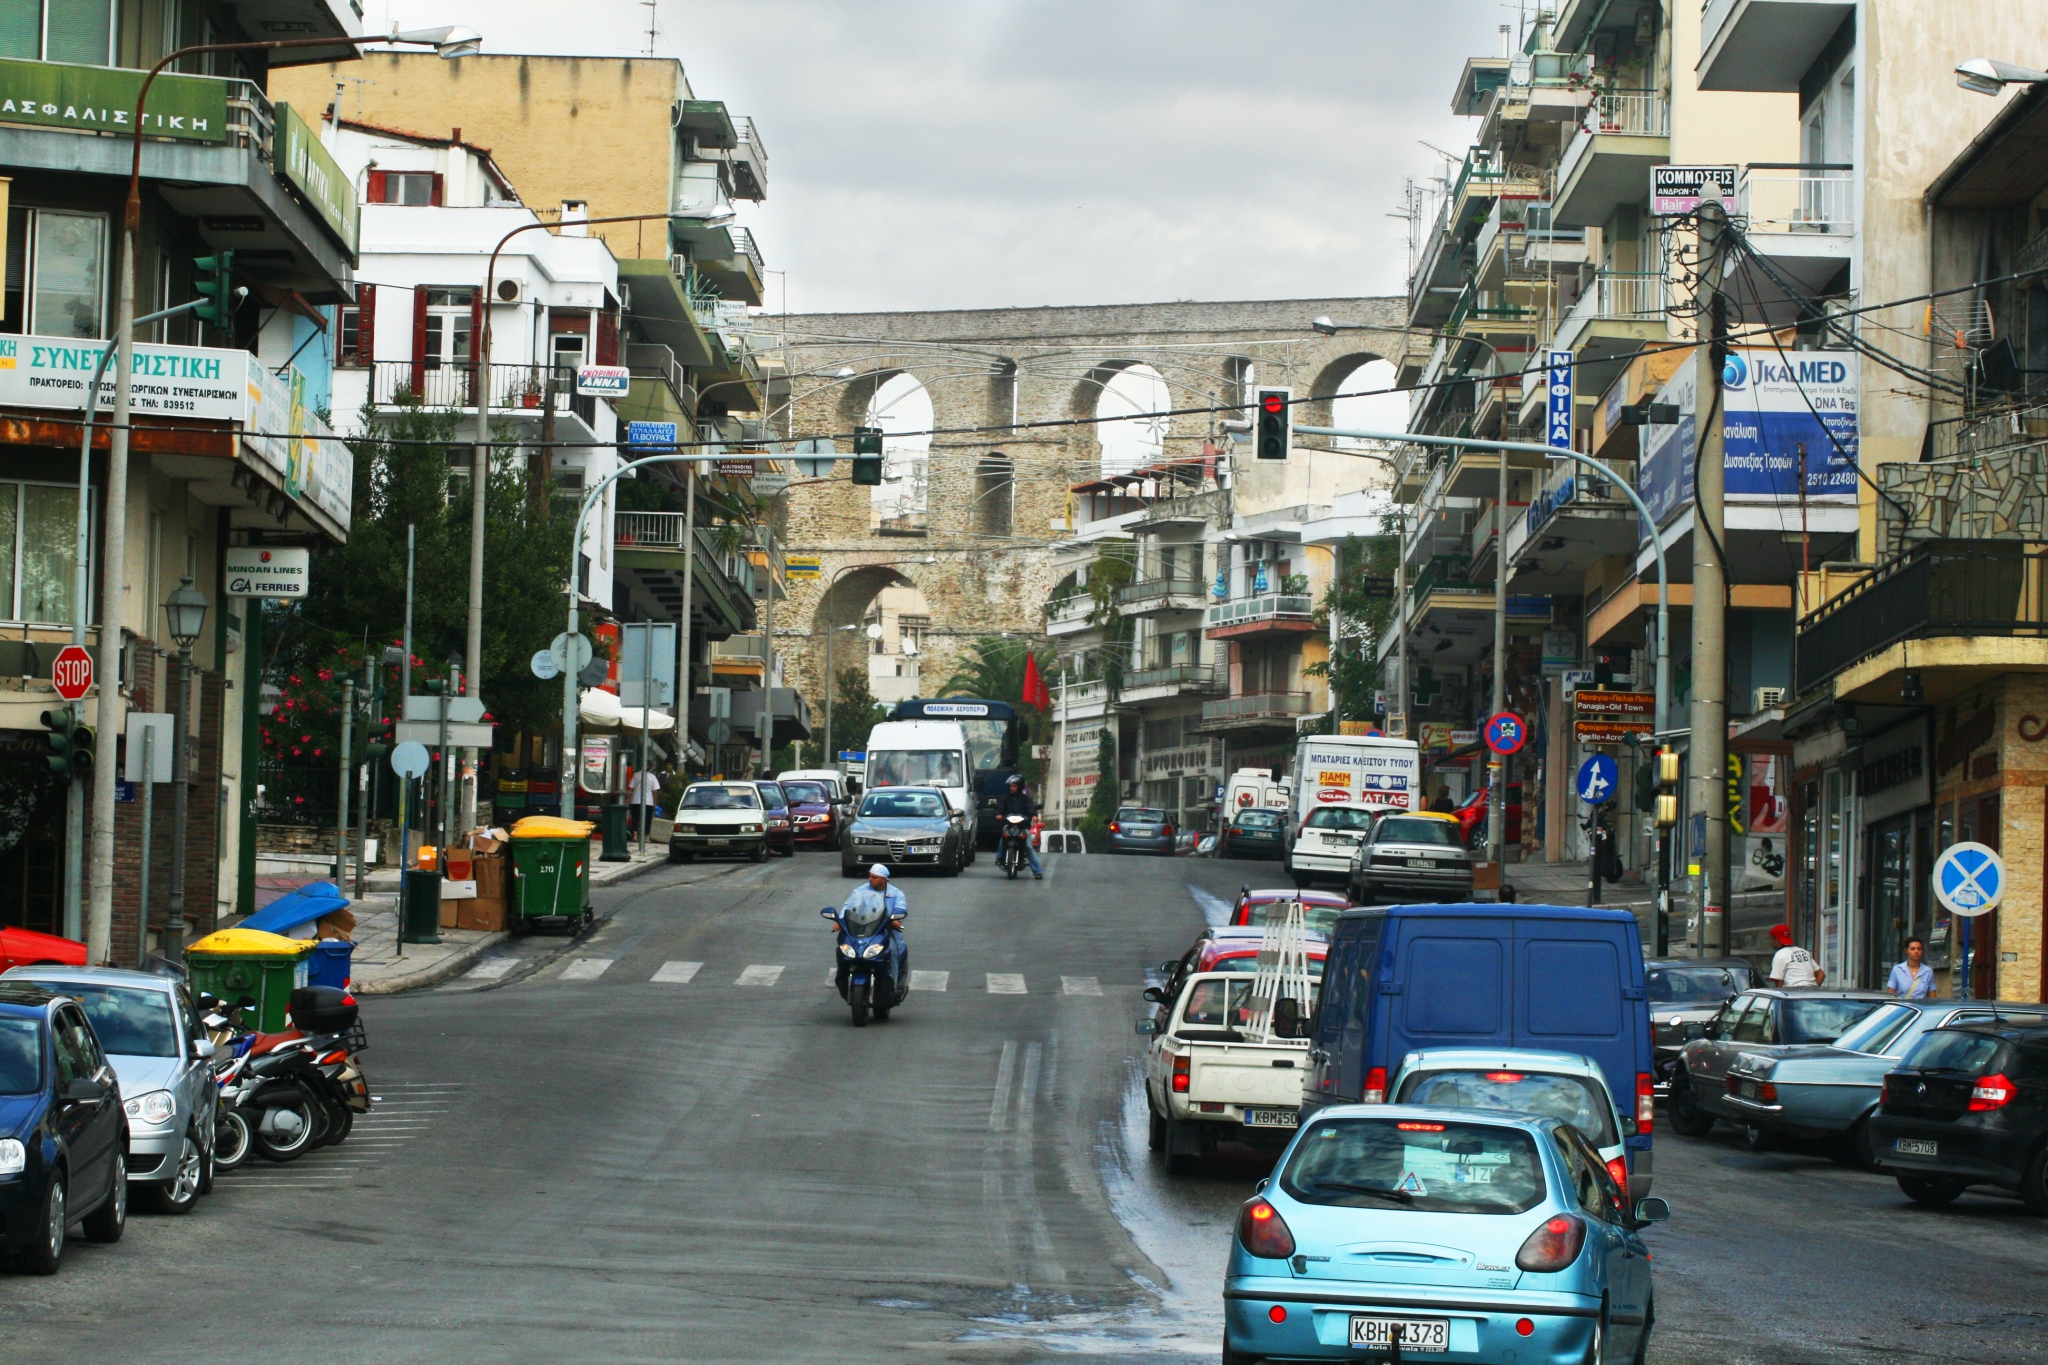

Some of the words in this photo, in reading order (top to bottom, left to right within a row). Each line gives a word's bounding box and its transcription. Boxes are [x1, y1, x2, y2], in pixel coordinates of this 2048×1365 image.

[2, 98, 208, 131] ΑΣΦΑΛΙΣΤΙΚΗ
[1657, 170, 1733, 185] ΚΟΜΜΩΣΕΙΣ
[1661, 199, 1686, 211] Hair
[29, 377, 83, 389] ΠΡΑΚΤΟΡΕΙΟ:
[173, 387, 238, 400] ΣΥΝΕΤΑΙΡΙΣΜΩΝ
[1551, 354, 1570, 440] ΝΥΦΙΚΑ
[163, 400, 194, 410] 839512
[1815, 397, 1837, 409] DNA
[1839, 398, 1856, 410] Tes
[1807, 473, 1828, 486] 2510
[227, 566, 271, 574] MINOAN
[273, 567, 303, 575] LINES
[255, 583, 300, 592] FERRIES
[56, 659, 90, 687] STOP
[1624, 703, 1644, 711] Town
[1065, 732, 1079, 744] FFICE
[1311, 754, 1351, 765] ΜΠΑΤΑΡΙΕΣ
[1353, 757, 1388, 767] ΚΛΕΙΣΤΟΥ
[1389, 759, 1414, 768] ΤΥΠΟΥ
[1320, 771, 1351, 782] FIAMM
[1364, 794, 1408, 805] ATLAS
